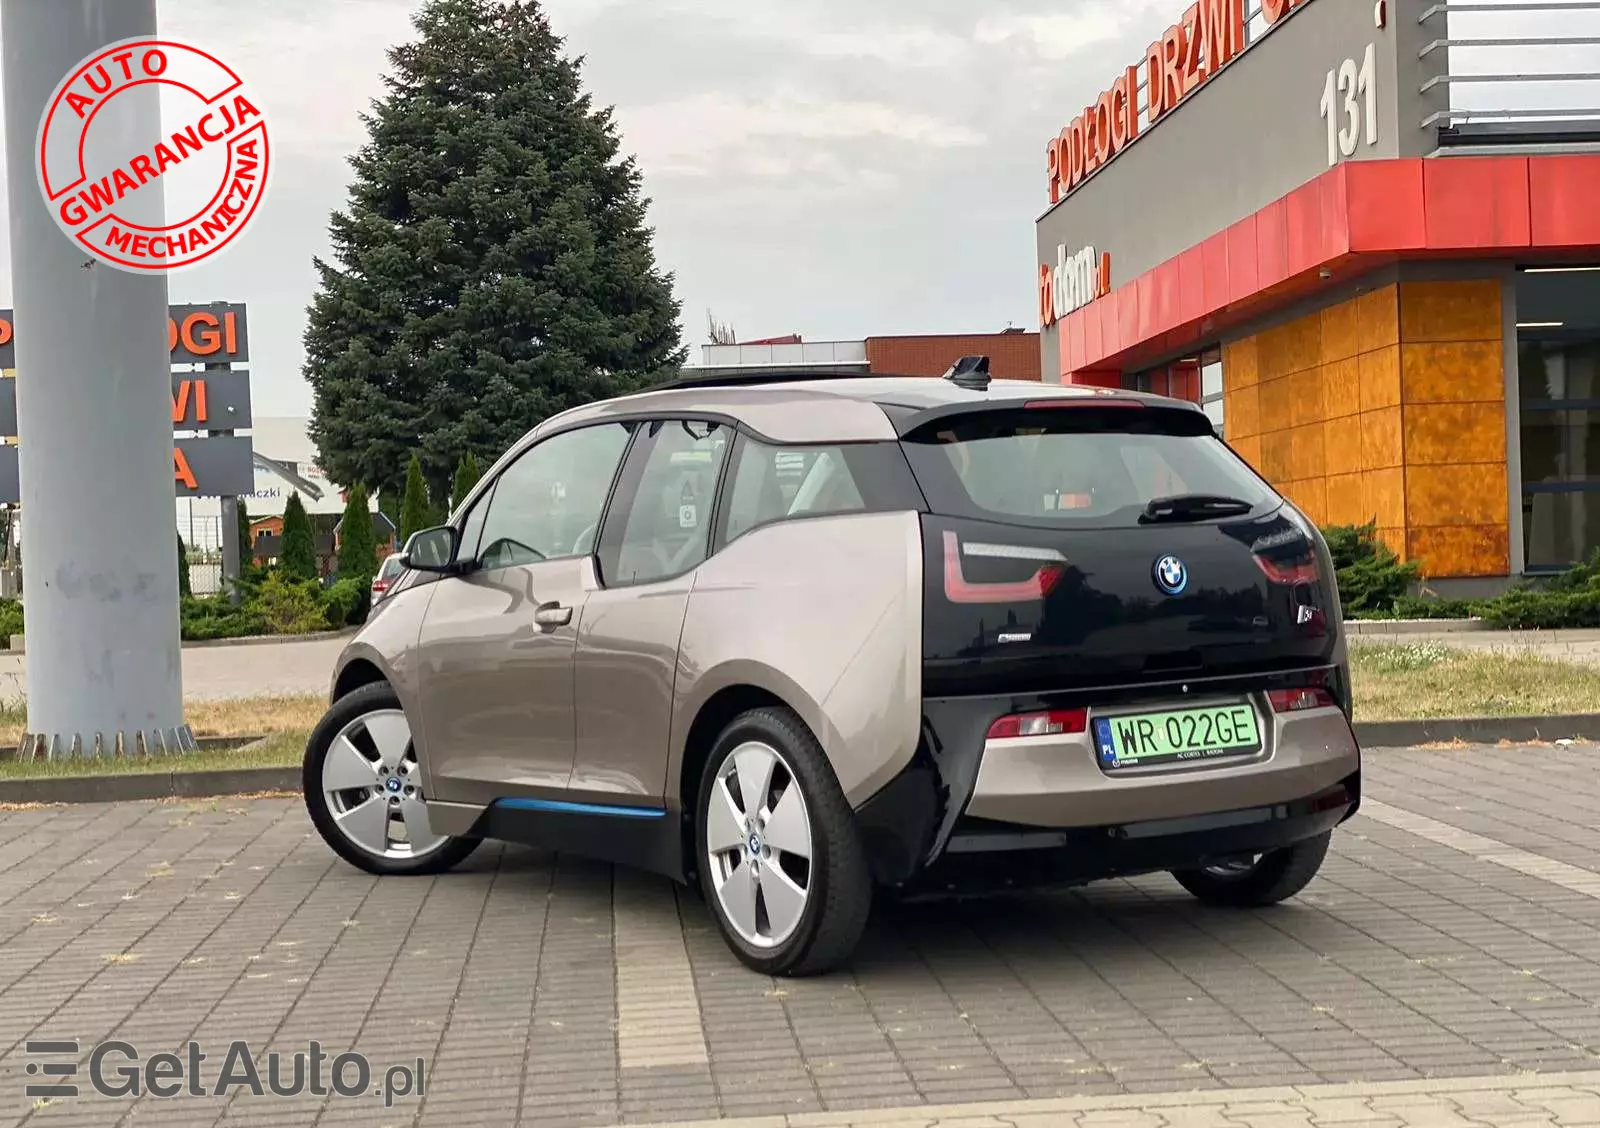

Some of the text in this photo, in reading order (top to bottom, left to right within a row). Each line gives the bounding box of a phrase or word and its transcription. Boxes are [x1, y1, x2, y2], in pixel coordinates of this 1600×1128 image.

[1047, 0, 1245, 204] PODŁOGI DRZWI
[1320, 43, 1377, 167] 131
[169, 311, 237, 355] GI
[1102, 744, 1114, 755] PL
[1117, 709, 1251, 755] WR 022GE
